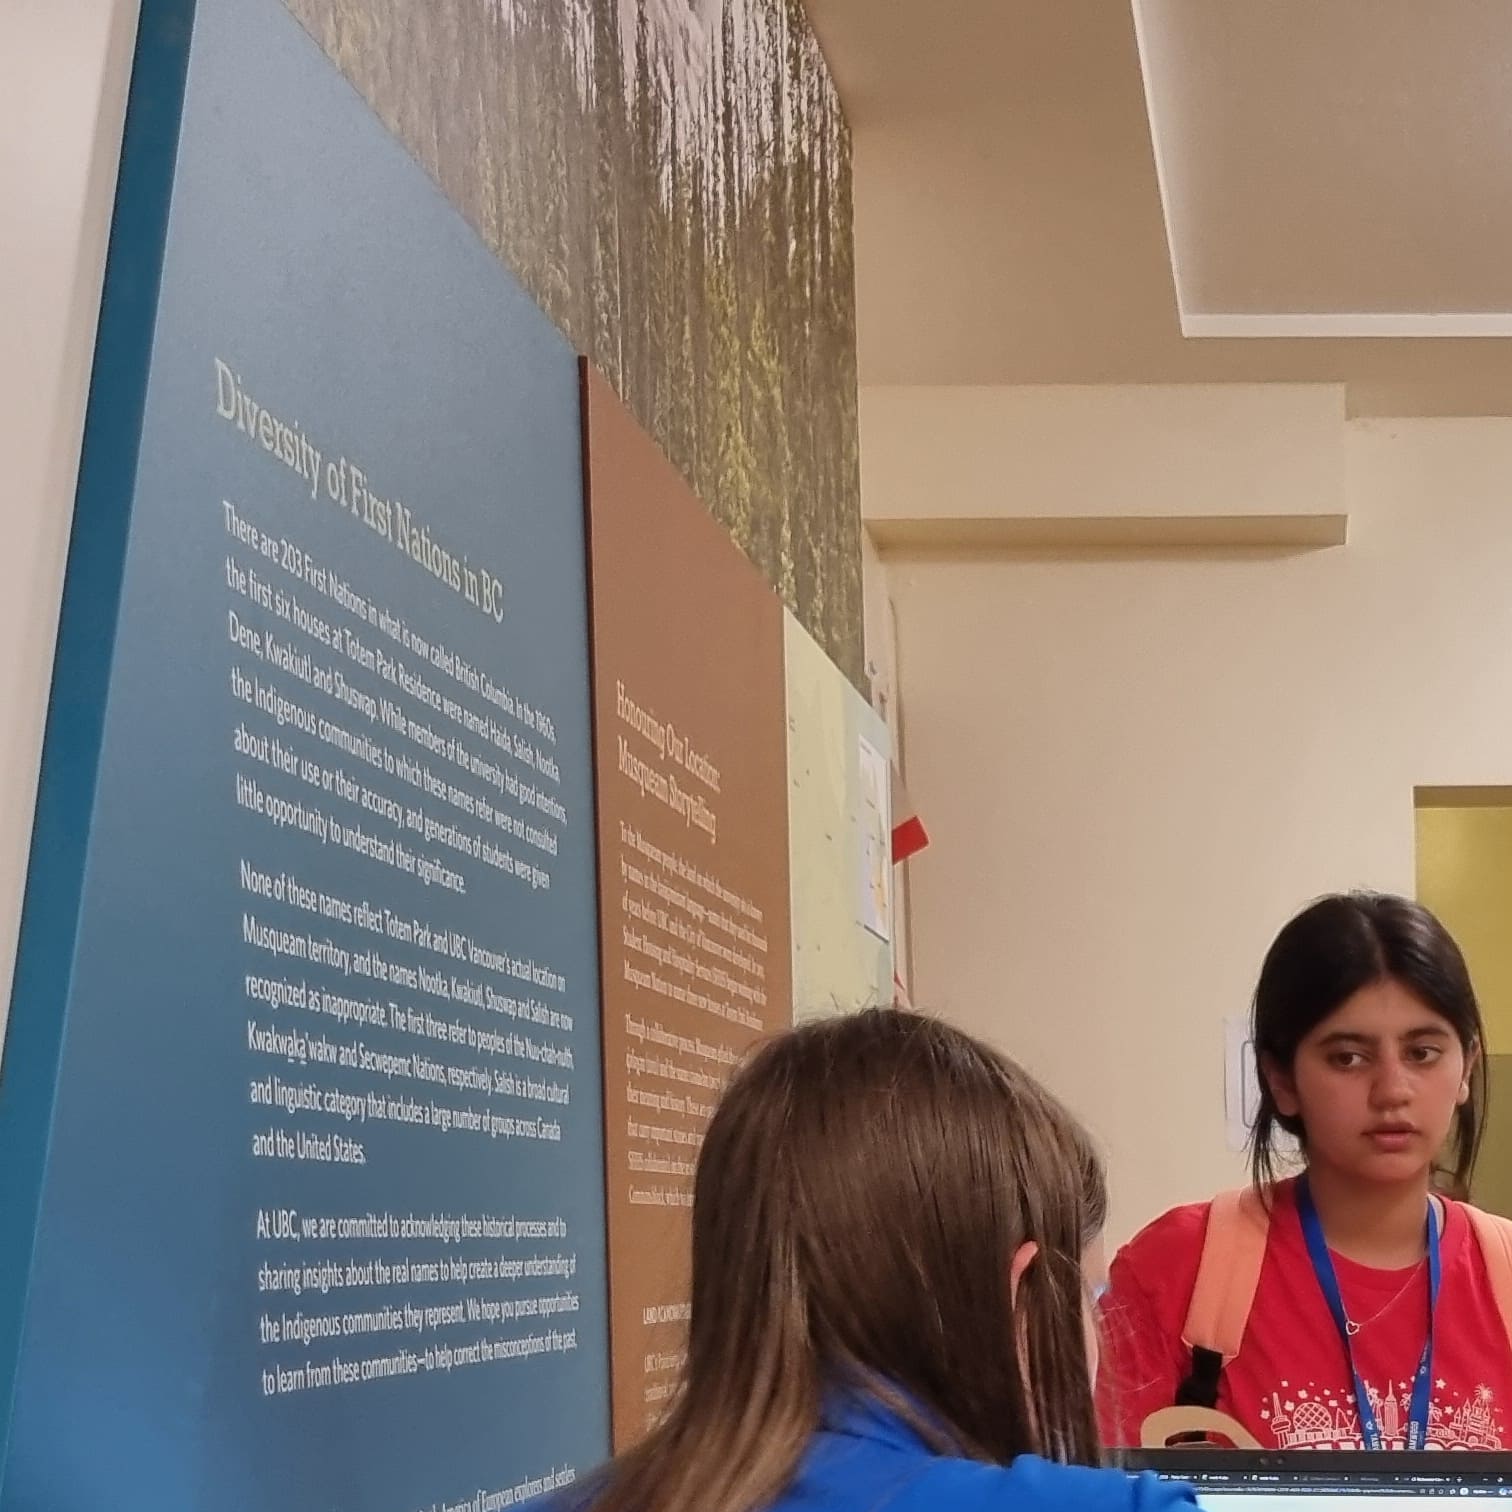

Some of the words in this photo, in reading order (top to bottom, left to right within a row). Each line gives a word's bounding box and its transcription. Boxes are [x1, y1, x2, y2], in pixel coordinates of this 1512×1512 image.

[214, 357, 321, 501] Diversity
[327, 455, 347, 507] of
[350, 465, 393, 542] First
[397, 501, 461, 592] Nations
[463, 553, 480, 607] in
[480, 568, 505, 624] BC
[222, 500, 258, 550] There
[260, 532, 279, 563] are
[280, 538, 303, 578] 203
[304, 553, 327, 595] First
[329, 570, 367, 620] Nations
[367, 597, 377, 627] in
[378, 608, 401, 643] what
[401, 619, 410, 649] is
[410, 633, 429, 660] now
[429, 644, 454, 677] called
[226, 556, 246, 595] the
[248, 568, 273, 611] first
[275, 589, 291, 622] six
[292, 595, 331, 645] houses
[331, 626, 343, 653] at
[343, 628, 375, 671] Totem
[376, 648, 397, 685] Park
[398, 662, 441, 711] Residence
[442, 696, 462, 724] were
[228, 610, 263, 660] Dene,
[265, 631, 311, 683] Kwakiutl
[312, 666, 333, 695] and
[334, 671, 378, 722] Shuswap.
[379, 697, 407, 735] While
[407, 720, 446, 757] members
[446, 736, 455, 762] of
[615, 680, 665, 764] Honouring
[231, 666, 252, 703] the
[254, 678, 316, 735] Indigenous
[318, 718, 382, 768] communities
[383, 746, 394, 774] to
[395, 754, 422, 787] which
[423, 767, 447, 801] these
[234, 722, 269, 764] about
[271, 738, 298, 775] their
[301, 759, 320, 787] use
[321, 769, 334, 791] or
[335, 769, 359, 803] their
[361, 787, 404, 828] accuracy,
[406, 807, 423, 833] and
[424, 817, 472, 855] generations
[617, 735, 670, 807] Musqueam
[669, 774, 717, 845] Storytelling
[236, 773, 263, 813] little
[265, 795, 327, 844] opportunity
[329, 815, 341, 844] to
[342, 825, 394, 865] understand
[395, 842, 416, 873] their
[417, 854, 465, 894] significance.
[240, 859, 272, 898] None
[272, 872, 285, 901] of
[287, 876, 317, 912] these
[318, 893, 352, 923] names
[353, 901, 383, 934] reflect
[383, 908, 412, 942] Totem
[413, 919, 432, 949] Park
[432, 929, 448, 955] and
[448, 931, 467, 961] UBC
[243, 914, 306, 958] Musqueam
[307, 934, 351, 976] territory,
[353, 949, 371, 977] and
[371, 951, 388, 981] the
[388, 963, 417, 989] names
[418, 965, 450, 1000] Nootka,
[245, 976, 306, 1009] recognized
[308, 989, 320, 1012] as
[322, 987, 387, 1027] inappropriate.
[388, 1002, 406, 1032] The
[407, 1006, 425, 1035] first
[425, 1012, 447, 1041] three
[448, 1018, 467, 1045] refer
[250, 1075, 272, 1105] and
[274, 1076, 322, 1114] linguistic
[323, 1088, 366, 1122] category
[366, 1091, 387, 1119] that
[387, 1095, 423, 1124] includes
[424, 1105, 430, 1125] a
[430, 1100, 451, 1132] large
[452, 1106, 481, 1131] number
[338, 1040, 358, 1068] and
[358, 1042, 411, 1079] Secwepemc
[412, 1053, 447, 1086] Nations,
[252, 1127, 274, 1157] and
[275, 1128, 295, 1159] the
[296, 1131, 332, 1161] United
[333, 1134, 366, 1164] States.
[256, 1209, 271, 1239] At
[272, 1209, 300, 1242] UBC,
[301, 1217, 318, 1239] we
[318, 1218, 336, 1239] are
[337, 1212, 388, 1238] committed
[389, 1214, 399, 1238] to
[400, 1213, 460, 1243] acknowledging
[258, 1261, 301, 1295] sharing
[302, 1260, 344, 1293] insights
[345, 1258, 373, 1286] about
[374, 1258, 391, 1285] the
[392, 1257, 409, 1283] real
[410, 1263, 439, 1282] names
[439, 1258, 449, 1281] to
[449, 1255, 468, 1285] help
[260, 1313, 280, 1342] the
[282, 1312, 341, 1343] Indigenous
[342, 1305, 403, 1333] communities
[403, 1302, 423, 1332] they
[424, 1300, 466, 1330] represent.
[262, 1369, 275, 1395] to
[276, 1364, 305, 1393] learn
[306, 1360, 331, 1388] from
[332, 1357, 360, 1385] these
[434, 1343, 453, 1372] help
[453, 1341, 481, 1366] correct
[542, 1467, 555, 1493] and
